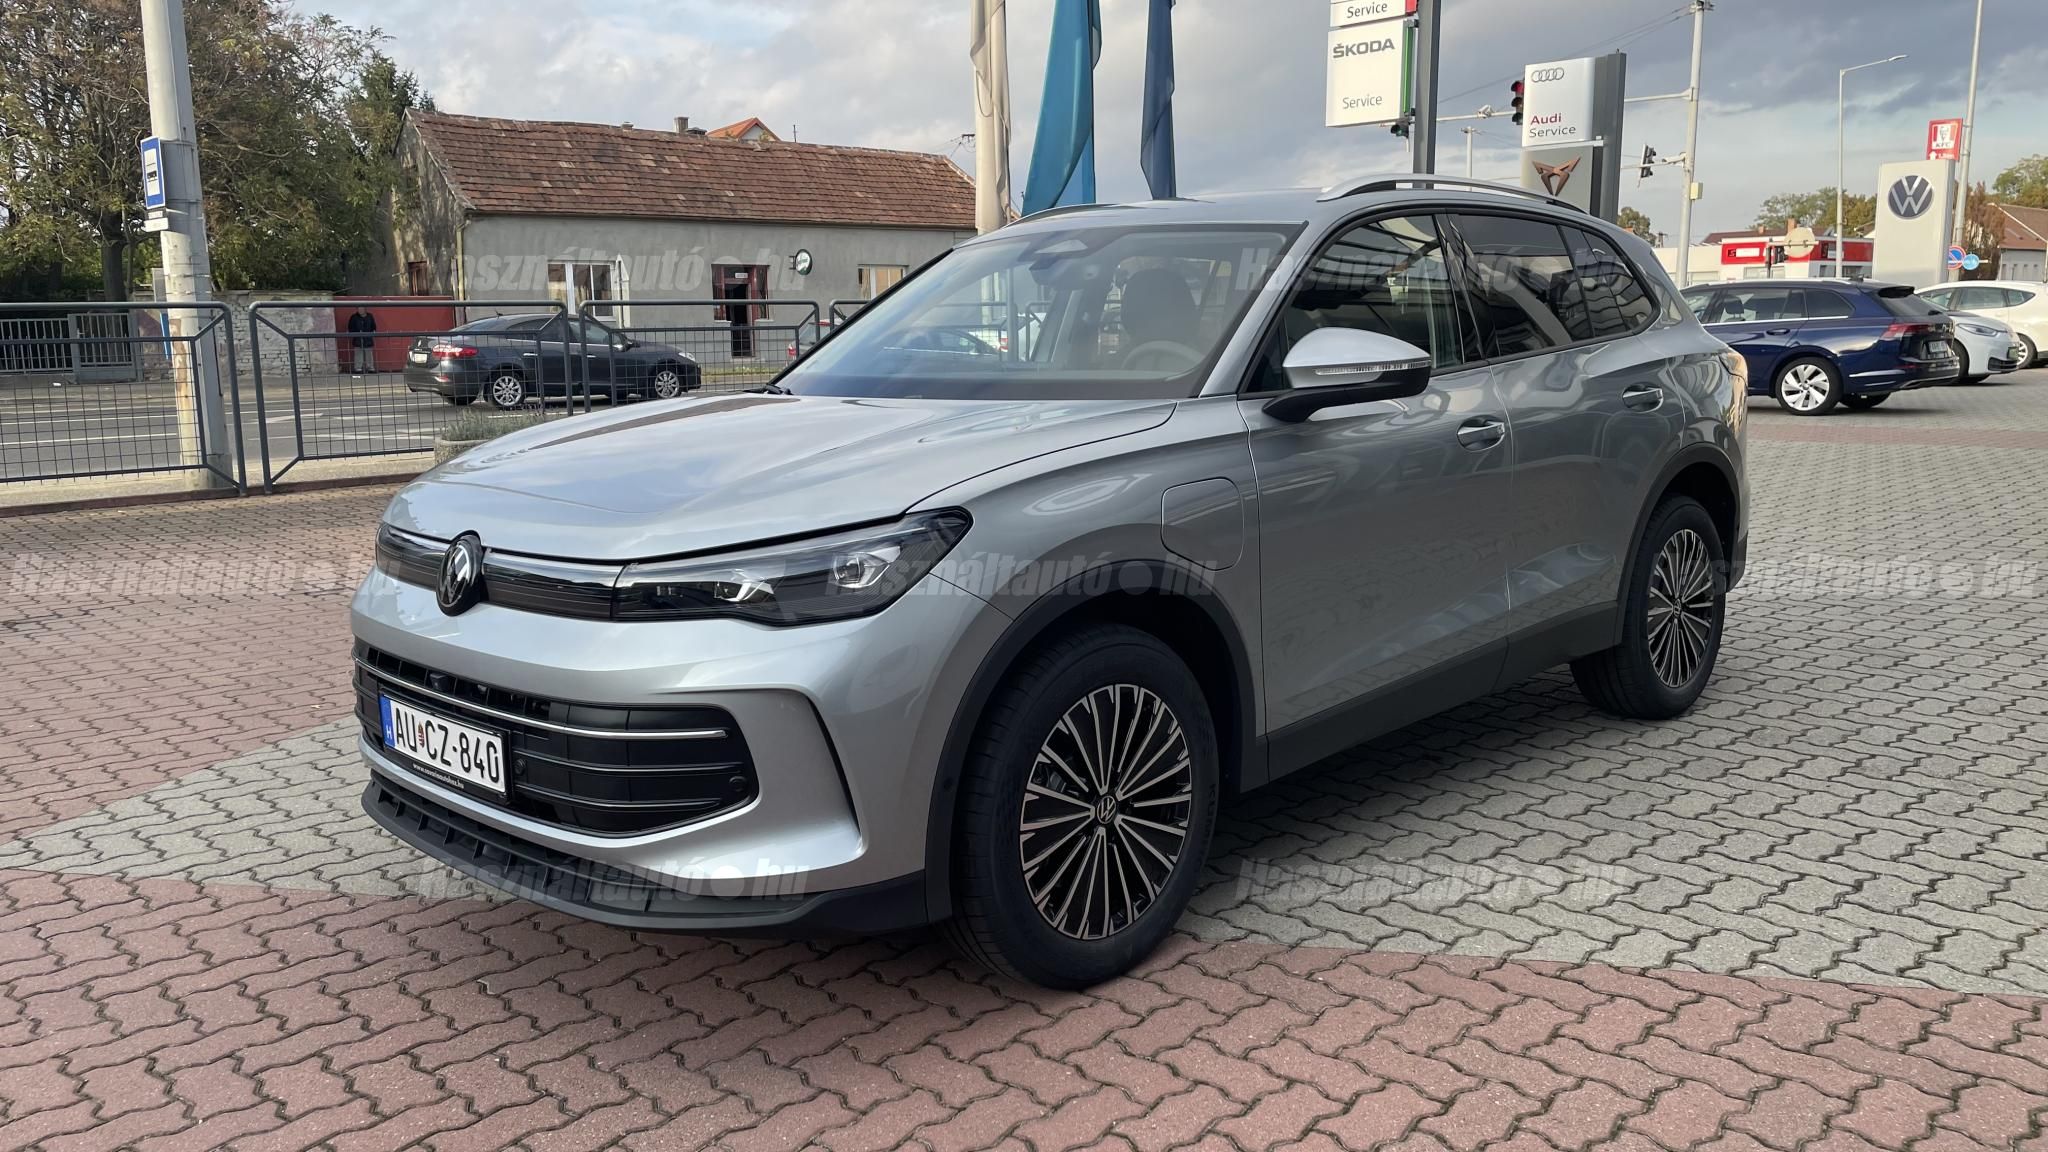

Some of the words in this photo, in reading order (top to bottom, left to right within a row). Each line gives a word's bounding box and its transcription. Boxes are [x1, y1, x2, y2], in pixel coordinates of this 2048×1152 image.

[1346, 2, 1388, 18] Service
[1333, 38, 1395, 58] ŠKODA
[1342, 94, 1383, 109] Service
[1531, 113, 1562, 125] Audi
[1529, 126, 1576, 138] Service
[386, 725, 393, 739] H
